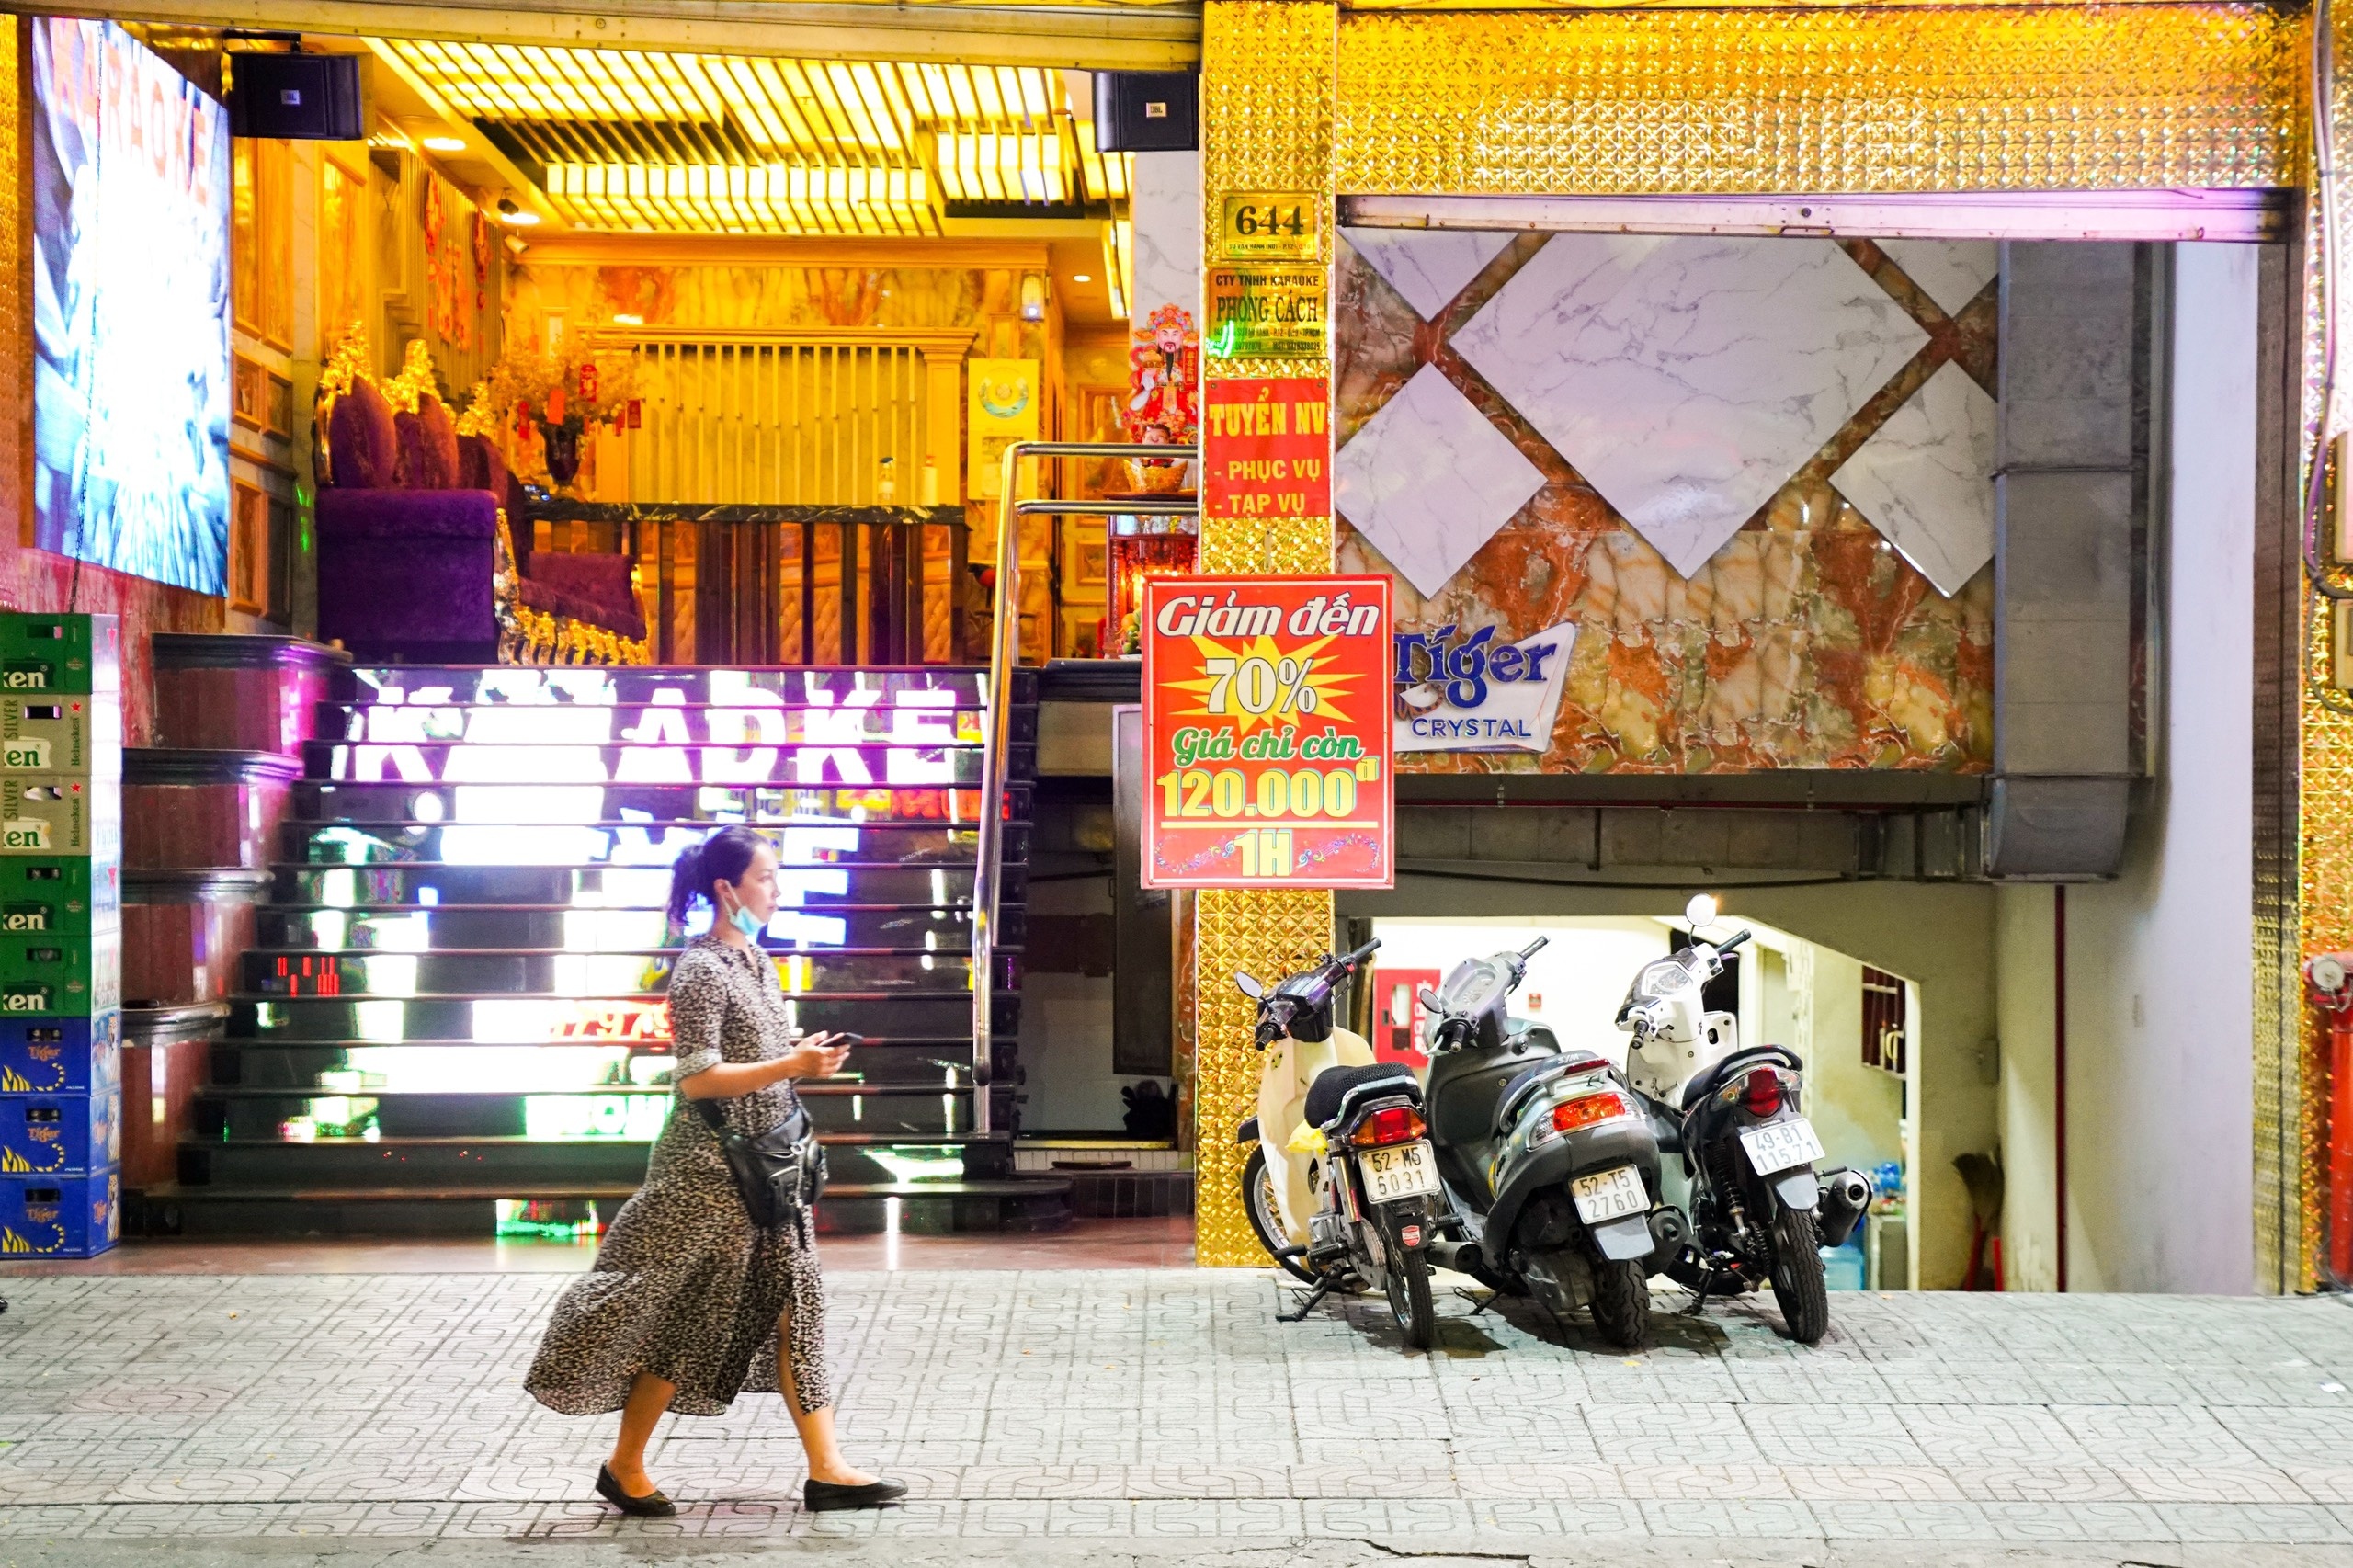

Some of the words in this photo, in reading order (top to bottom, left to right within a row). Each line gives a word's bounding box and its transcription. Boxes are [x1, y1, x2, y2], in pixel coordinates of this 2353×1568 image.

[1235, 205, 1303, 235] 644
[1216, 275, 1234, 286] CTY
[1240, 275, 1267, 286] TNHH
[1270, 275, 1319, 286] KARAOKE
[1216, 297, 1269, 322] PHONG
[1275, 290, 1317, 322] CÁCH
[1209, 387, 1286, 437] TUYỂN
[1294, 402, 1326, 435] NV
[1228, 460, 1286, 483] PHỤC
[1292, 459, 1321, 482] VỤ
[1228, 494, 1271, 517] TẠP
[1278, 493, 1305, 516] VỤ
[1156, 590, 1283, 637] Giảm
[1288, 592, 1380, 636] đến
[1394, 625, 1558, 709] Tiger
[1206, 657, 1318, 714] 70%
[4, 700, 18, 739] SILVER
[1412, 718, 1533, 737] CRYSTAL
[71, 716, 80, 767] Heineken
[1173, 726, 1238, 767] Giá
[1240, 726, 1296, 760] chỉ
[1300, 727, 1365, 760] còn
[3, 749, 40, 767] en
[4, 780, 18, 820] SILVER
[71, 797, 80, 846] Heineken
[3, 830, 40, 847] en
[1233, 828, 1293, 877] 1H
[28, 1046, 61, 1062] Tiger
[28, 1127, 61, 1142] Tiger
[1756, 1125, 1802, 1151] 49-B1
[1371, 1147, 1422, 1172] 52-M5
[1756, 1141, 1817, 1171] 115.71
[1377, 1170, 1426, 1195] 6031
[1579, 1169, 1631, 1197] 52-T5
[26, 1208, 59, 1223] Tiger
[1588, 1190, 1638, 1219] 2760
